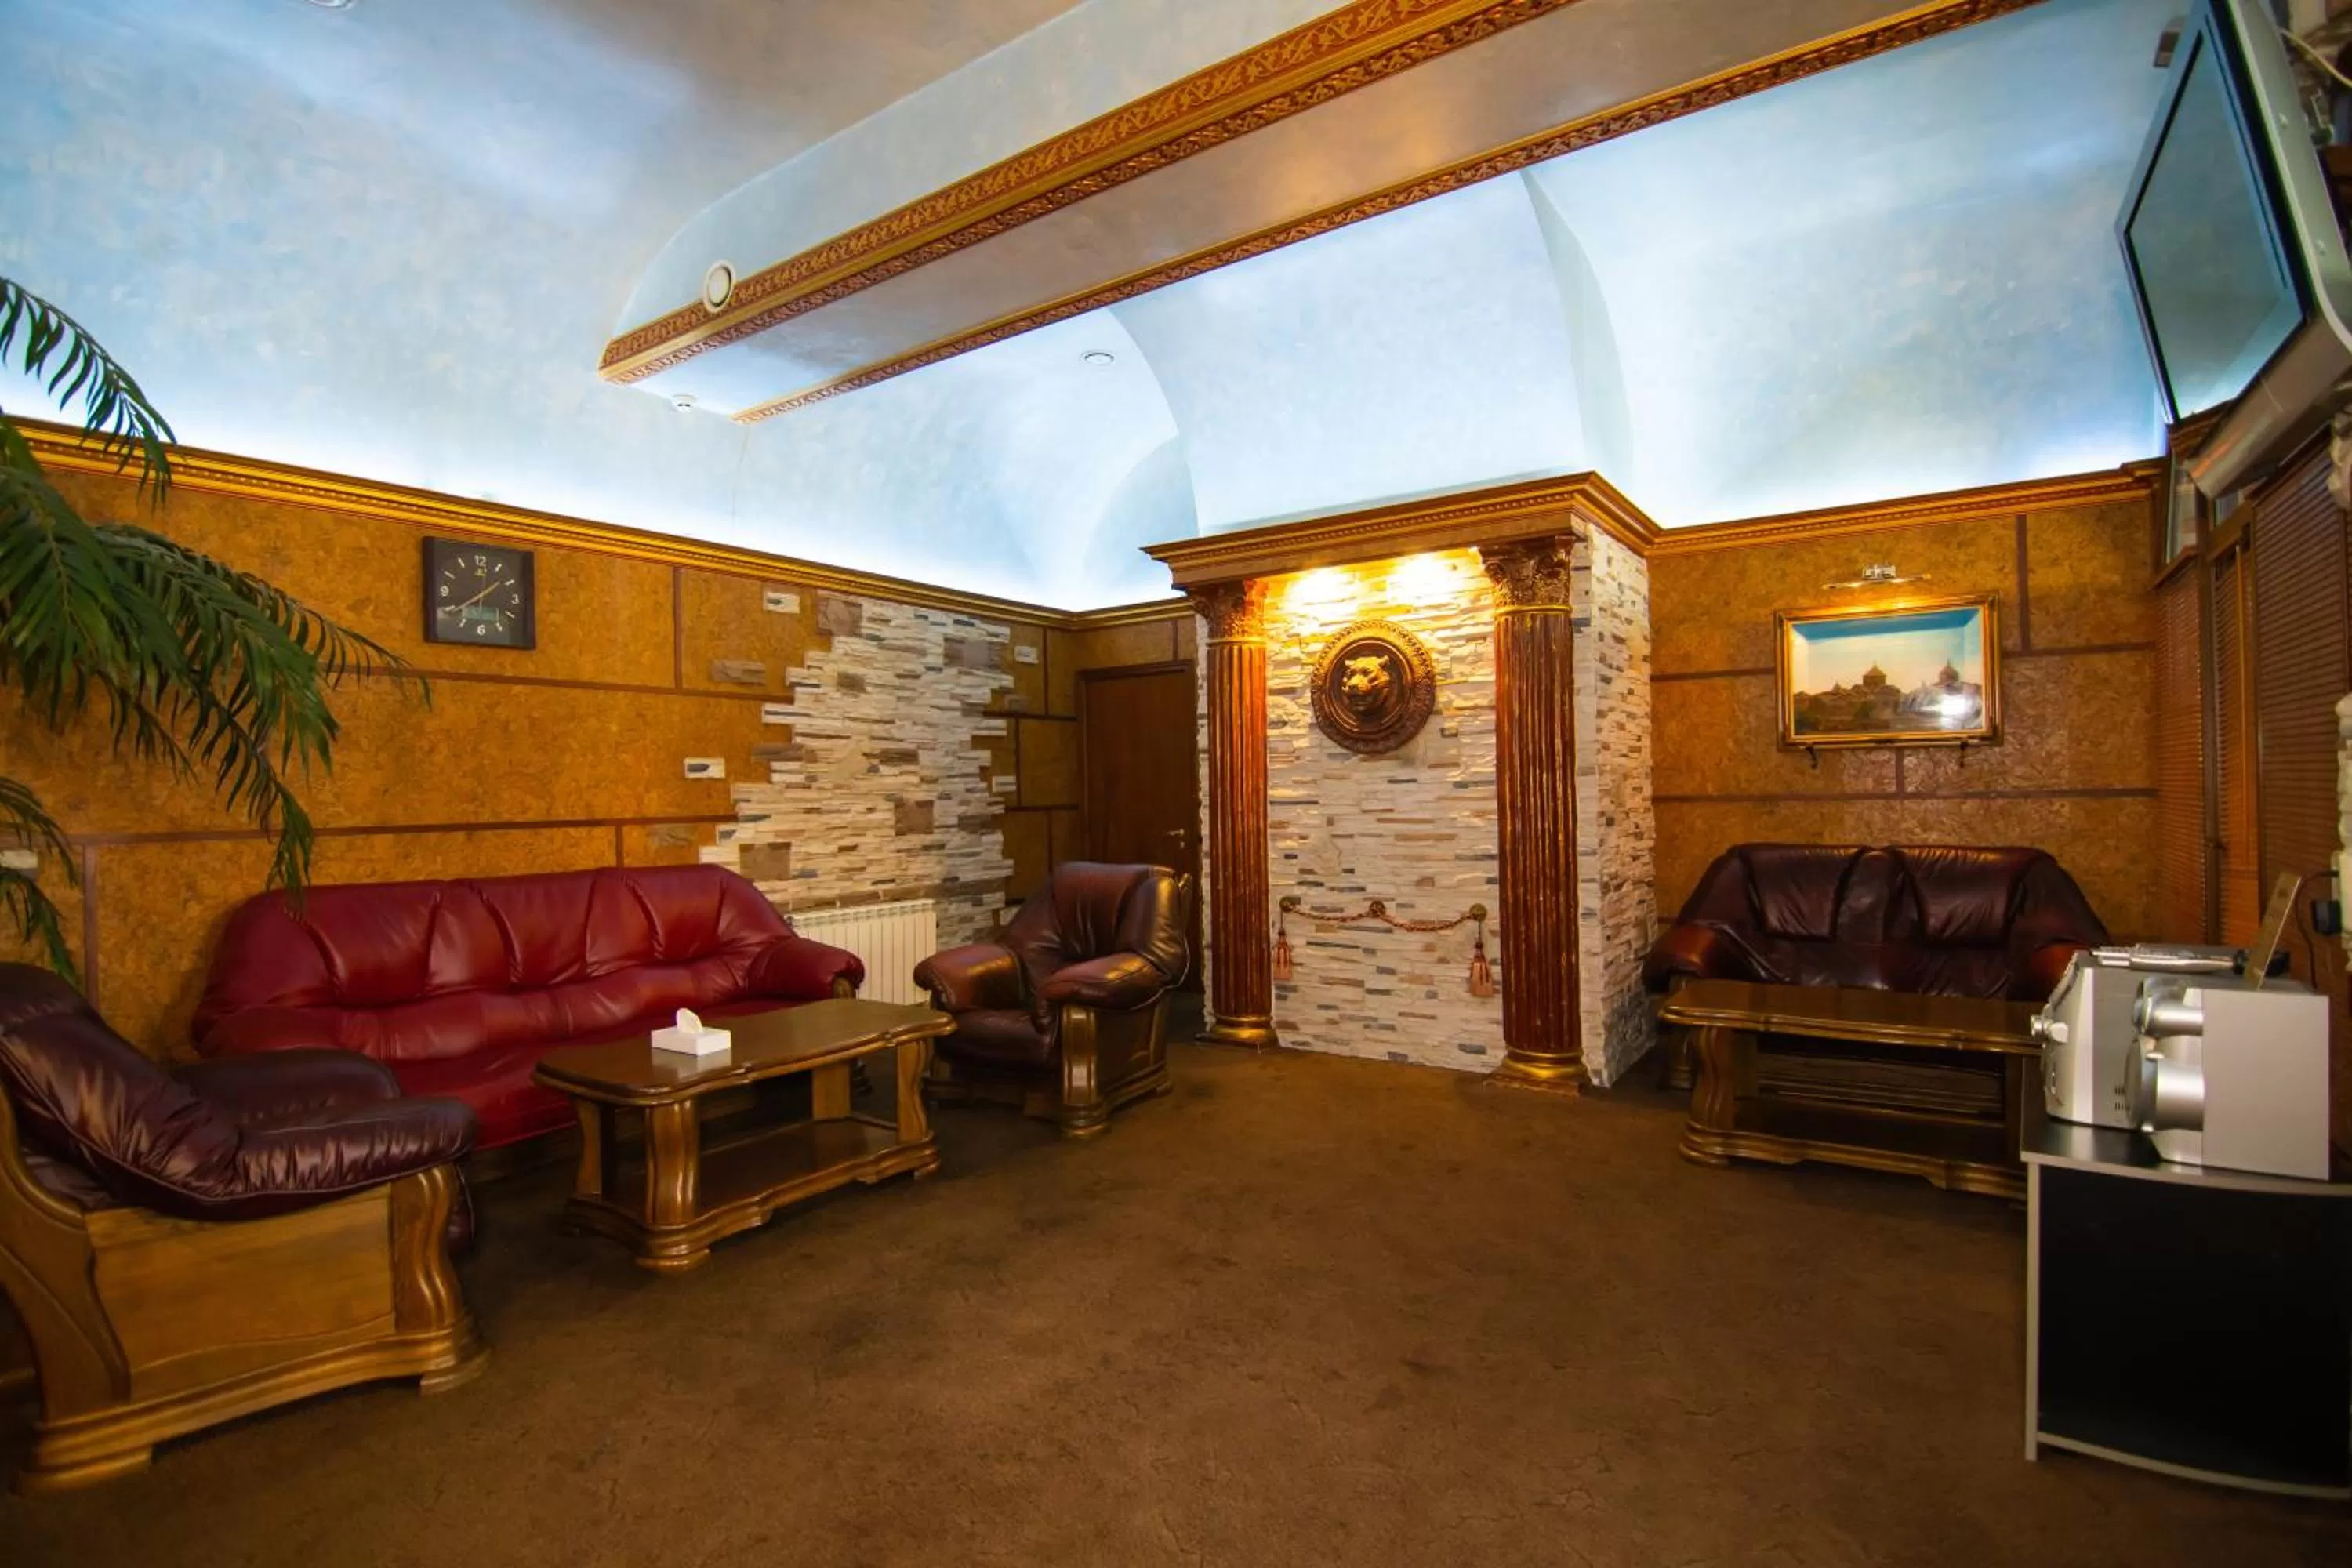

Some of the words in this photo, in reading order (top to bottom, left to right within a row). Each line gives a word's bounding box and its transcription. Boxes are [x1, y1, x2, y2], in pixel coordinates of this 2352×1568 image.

[474, 555, 487, 567] 12
[441, 586, 450, 597] 9
[511, 593, 520, 604] 3
[477, 624, 485, 636] 6
